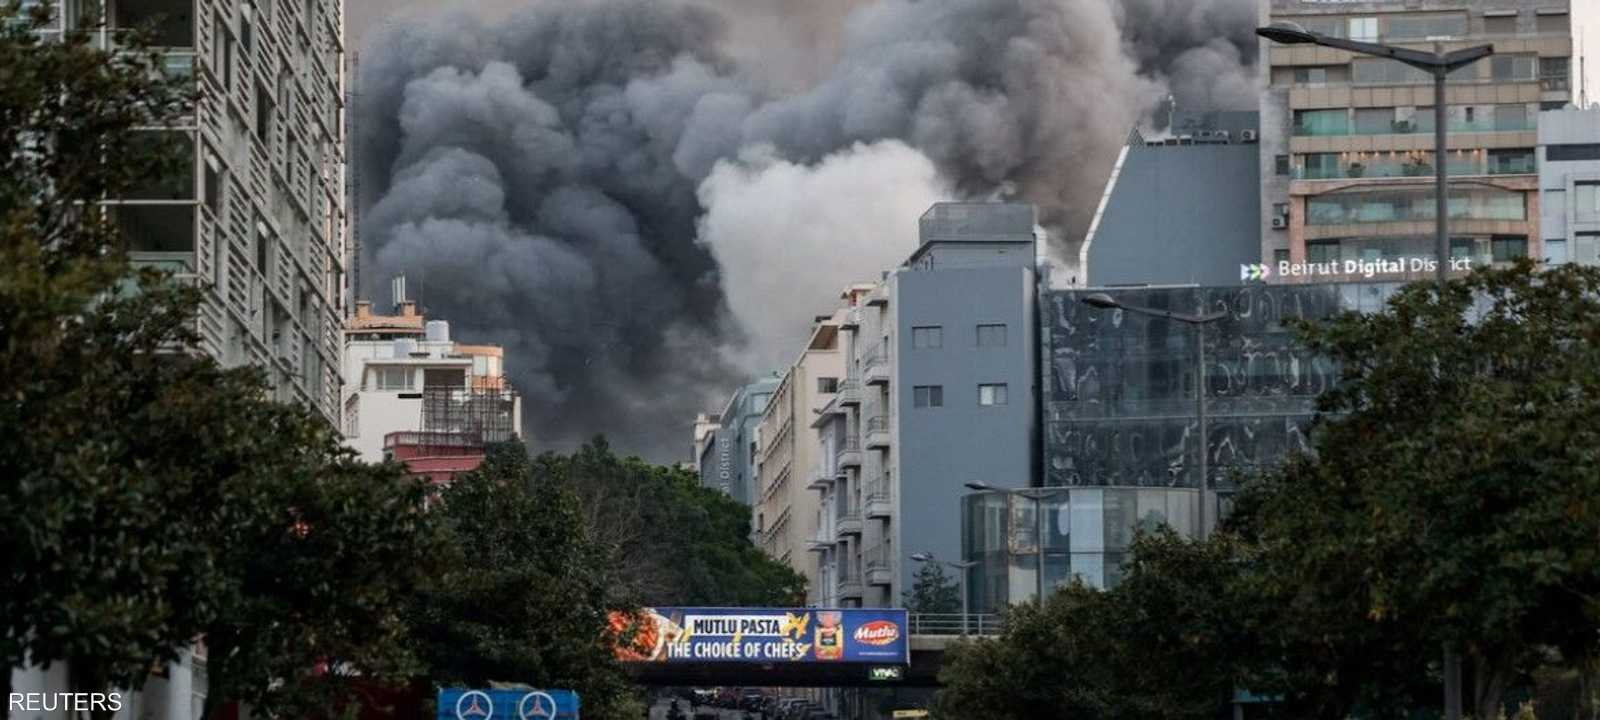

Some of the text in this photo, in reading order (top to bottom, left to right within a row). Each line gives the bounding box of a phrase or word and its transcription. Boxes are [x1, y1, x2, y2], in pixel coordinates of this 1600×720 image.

[1278, 256, 1472, 277] Beirut Digital Disict
[693, 619, 781, 634] MUTLU PASTA
[667, 642, 691, 658] THE
[694, 641, 741, 658] CHOICE
[744, 641, 761, 658] OF
